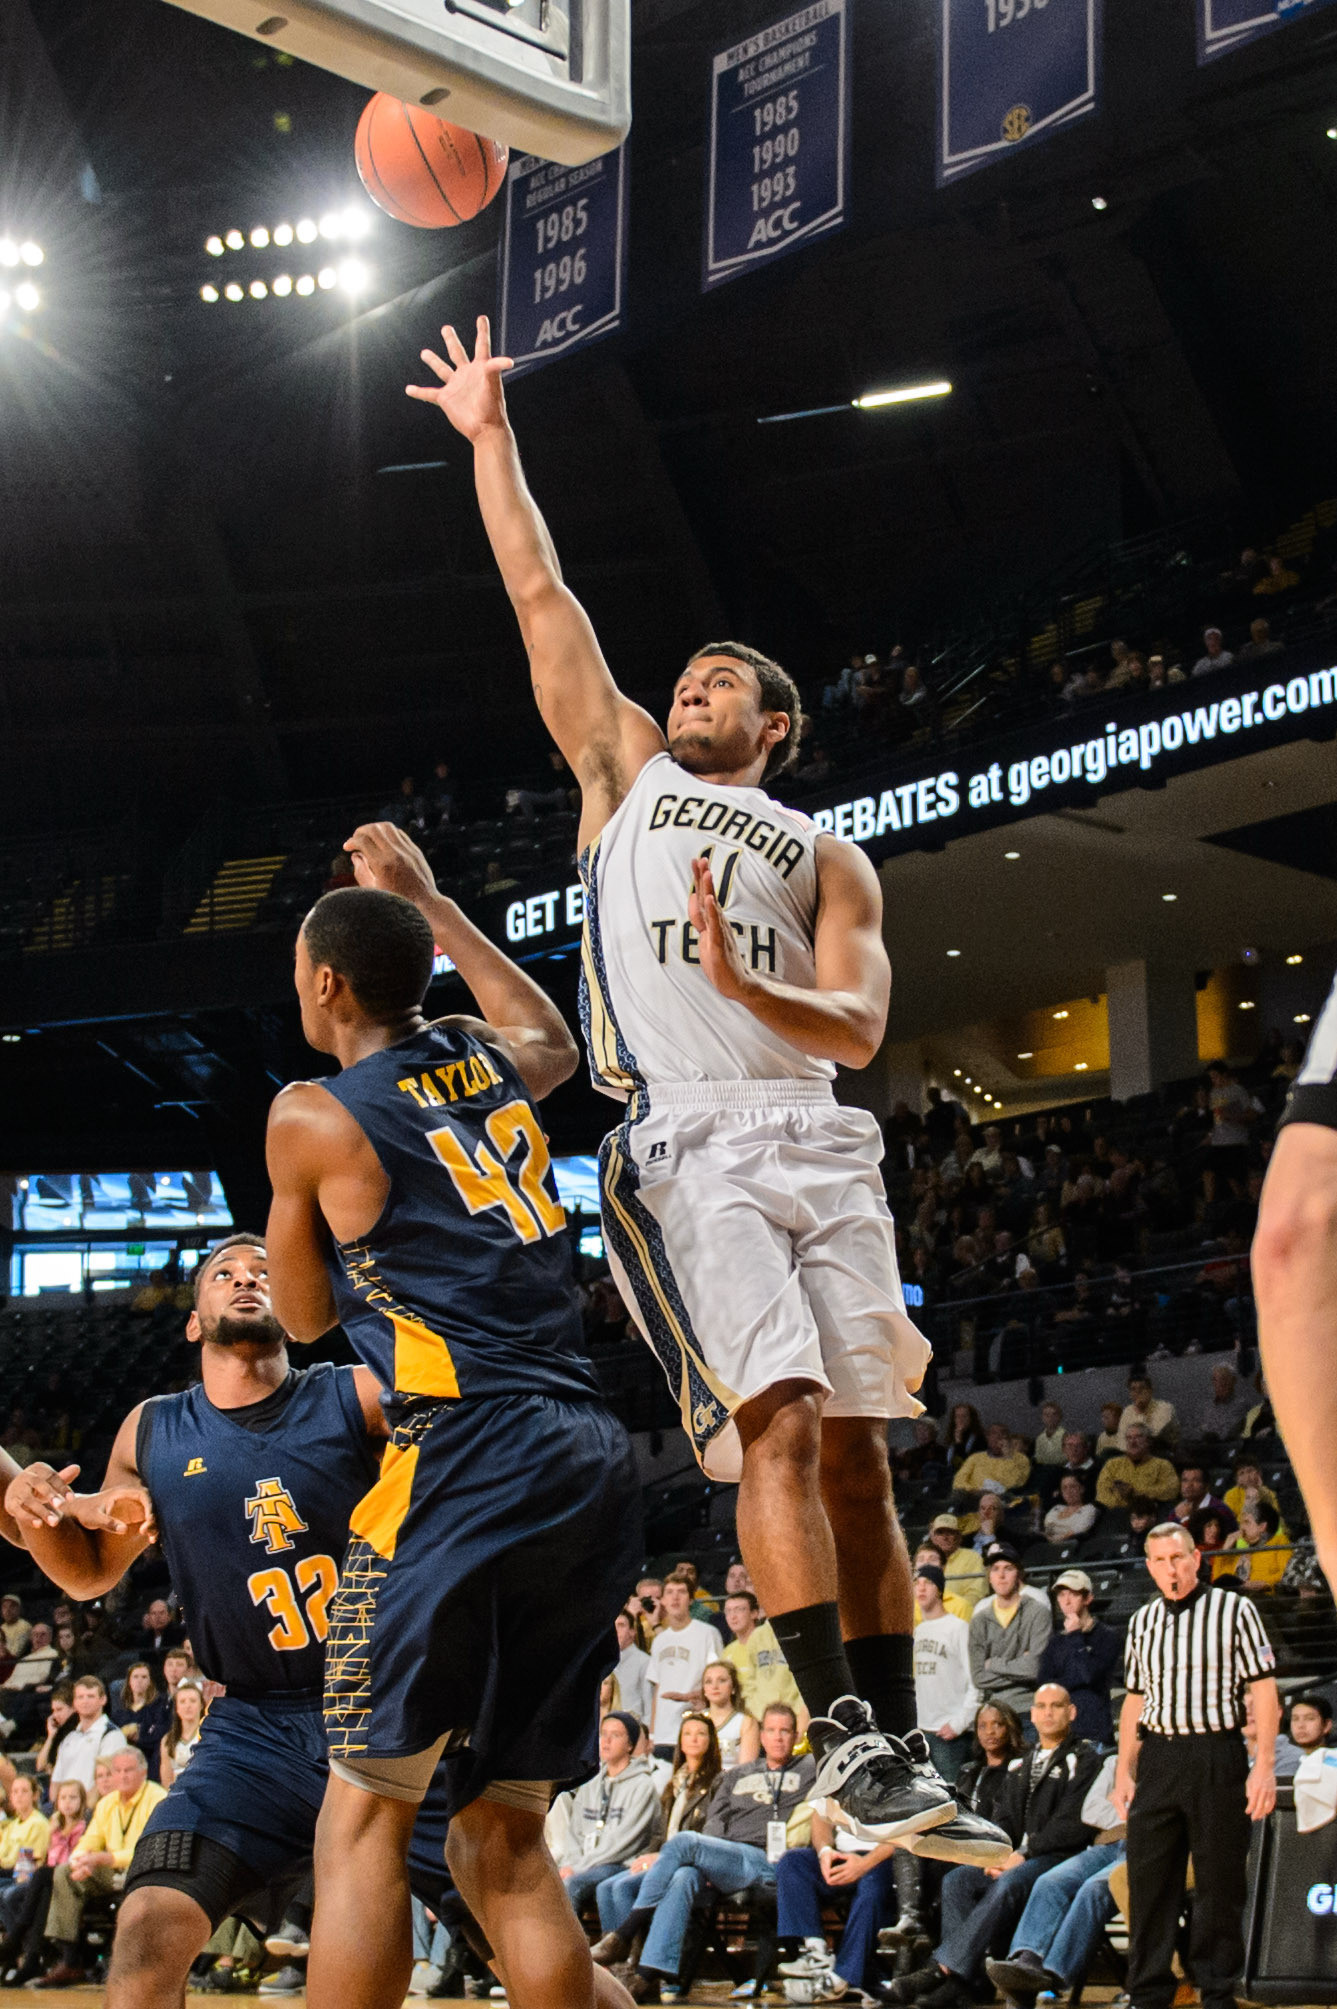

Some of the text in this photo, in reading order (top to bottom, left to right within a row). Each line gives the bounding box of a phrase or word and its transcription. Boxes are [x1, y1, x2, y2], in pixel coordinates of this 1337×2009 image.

[753, 90, 798, 136] 1985
[752, 127, 799, 173] 1990
[751, 165, 796, 211] 1993
[536, 198, 589, 254] 1985
[747, 201, 801, 249] ACC
[534, 248, 587, 303] 1996
[534, 304, 584, 349] ACC
[506, 890, 560, 942] GET
[813, 771, 959, 842] REBATES
[968, 762, 1003, 807] at
[1008, 665, 1337, 805] georgiapower.com
[648, 794, 806, 881] GEORGIA
[424, 1099, 567, 1245] 42
[247, 1554, 339, 1651] 32
